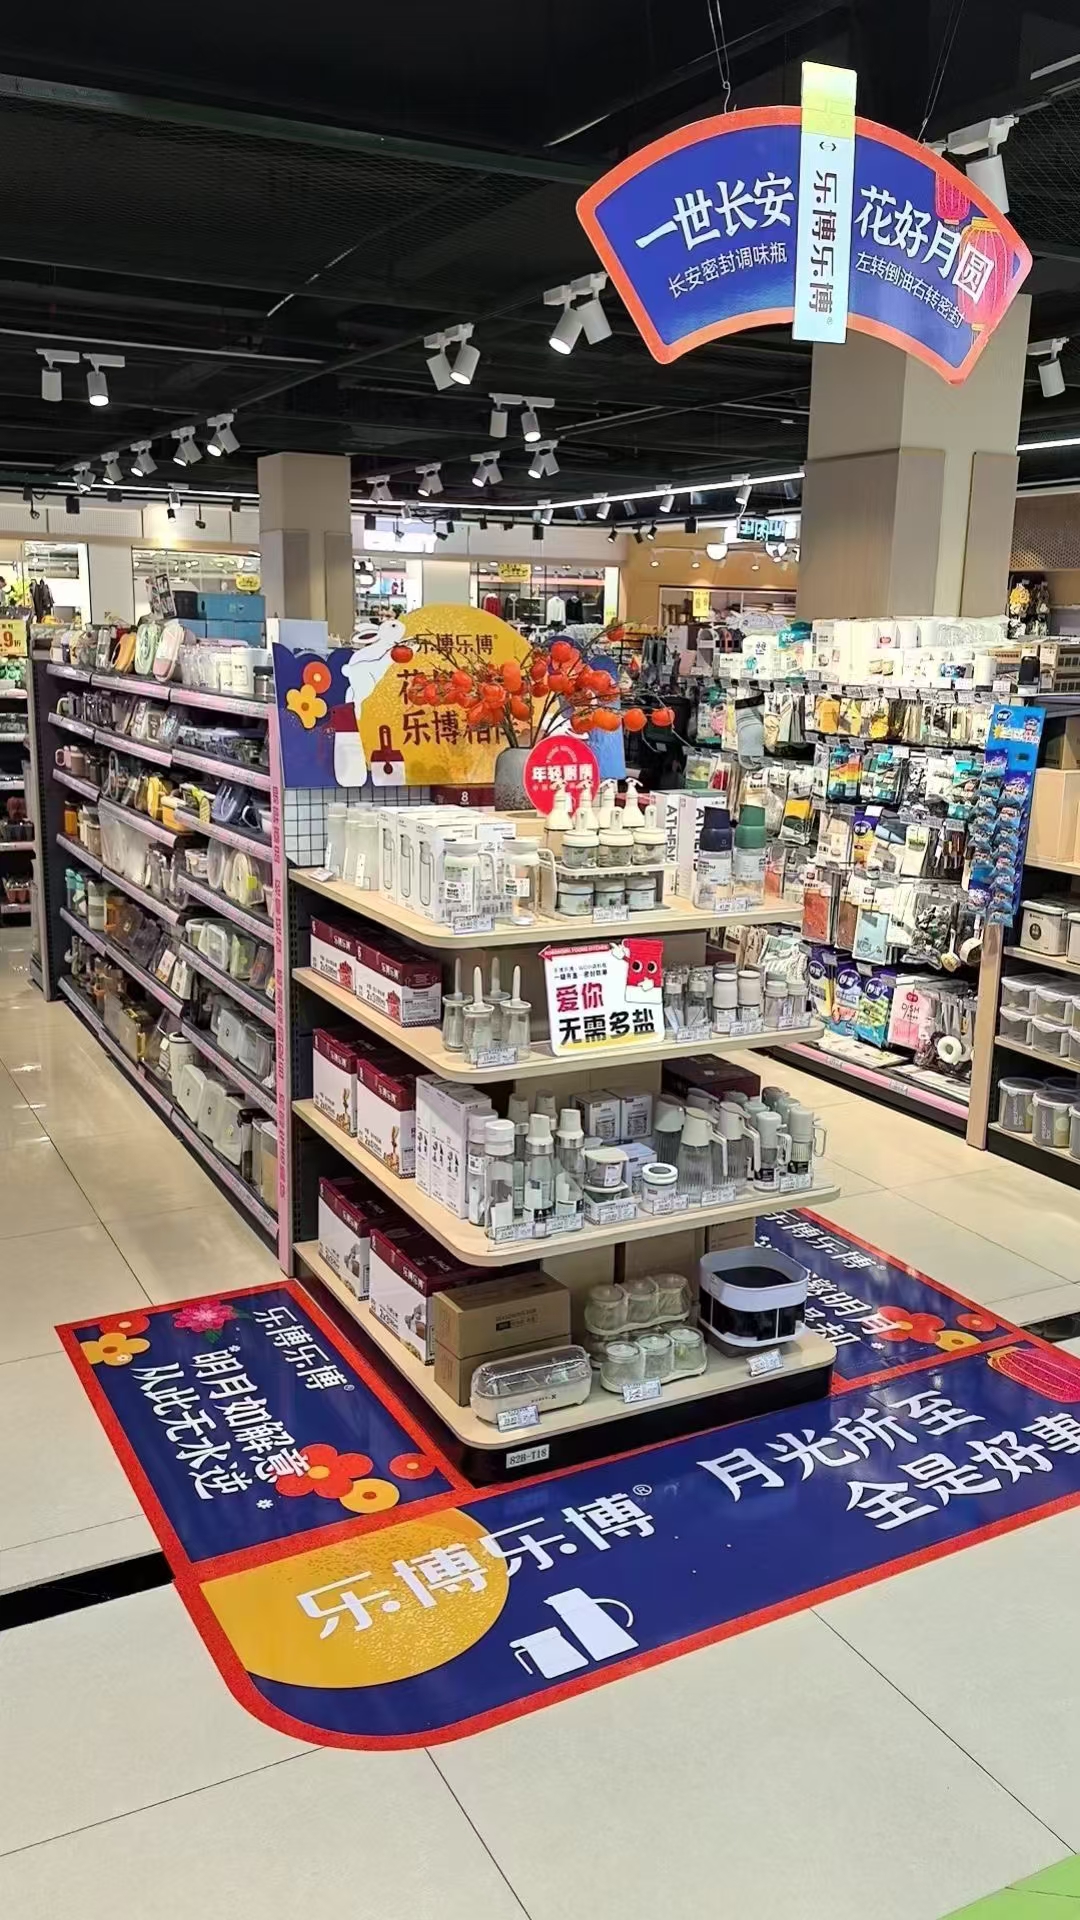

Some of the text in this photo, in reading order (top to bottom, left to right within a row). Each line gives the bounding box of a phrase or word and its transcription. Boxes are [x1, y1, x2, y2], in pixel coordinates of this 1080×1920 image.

[634, 171, 796, 251] 一世长安
[808, 169, 838, 314] 乐博乐博
[854, 184, 997, 303] 花好月圆
[667, 241, 789, 299] 长安密封调味瓶
[855, 249, 966, 330] 左转倒油右转密封
[415, 632, 494, 656] 乐博乐博
[402, 709, 519, 747] 乐博相
[461, 790, 469, 802] 8
[555, 982, 604, 1013] 爱你
[558, 1008, 656, 1046] 无需多盐
[764, 1209, 877, 1269] 乐博乐博
[806, 1272, 903, 1335] 邀明月
[252, 1304, 349, 1392] 乐博乐博
[131, 1362, 255, 1500] 从此无水逆
[190, 1350, 313, 1484] 明月如解意
[697, 1387, 985, 1504] 月光所至
[844, 1412, 1080, 1533] 全是好事
[295, 1491, 658, 1642] 乐博乐博
